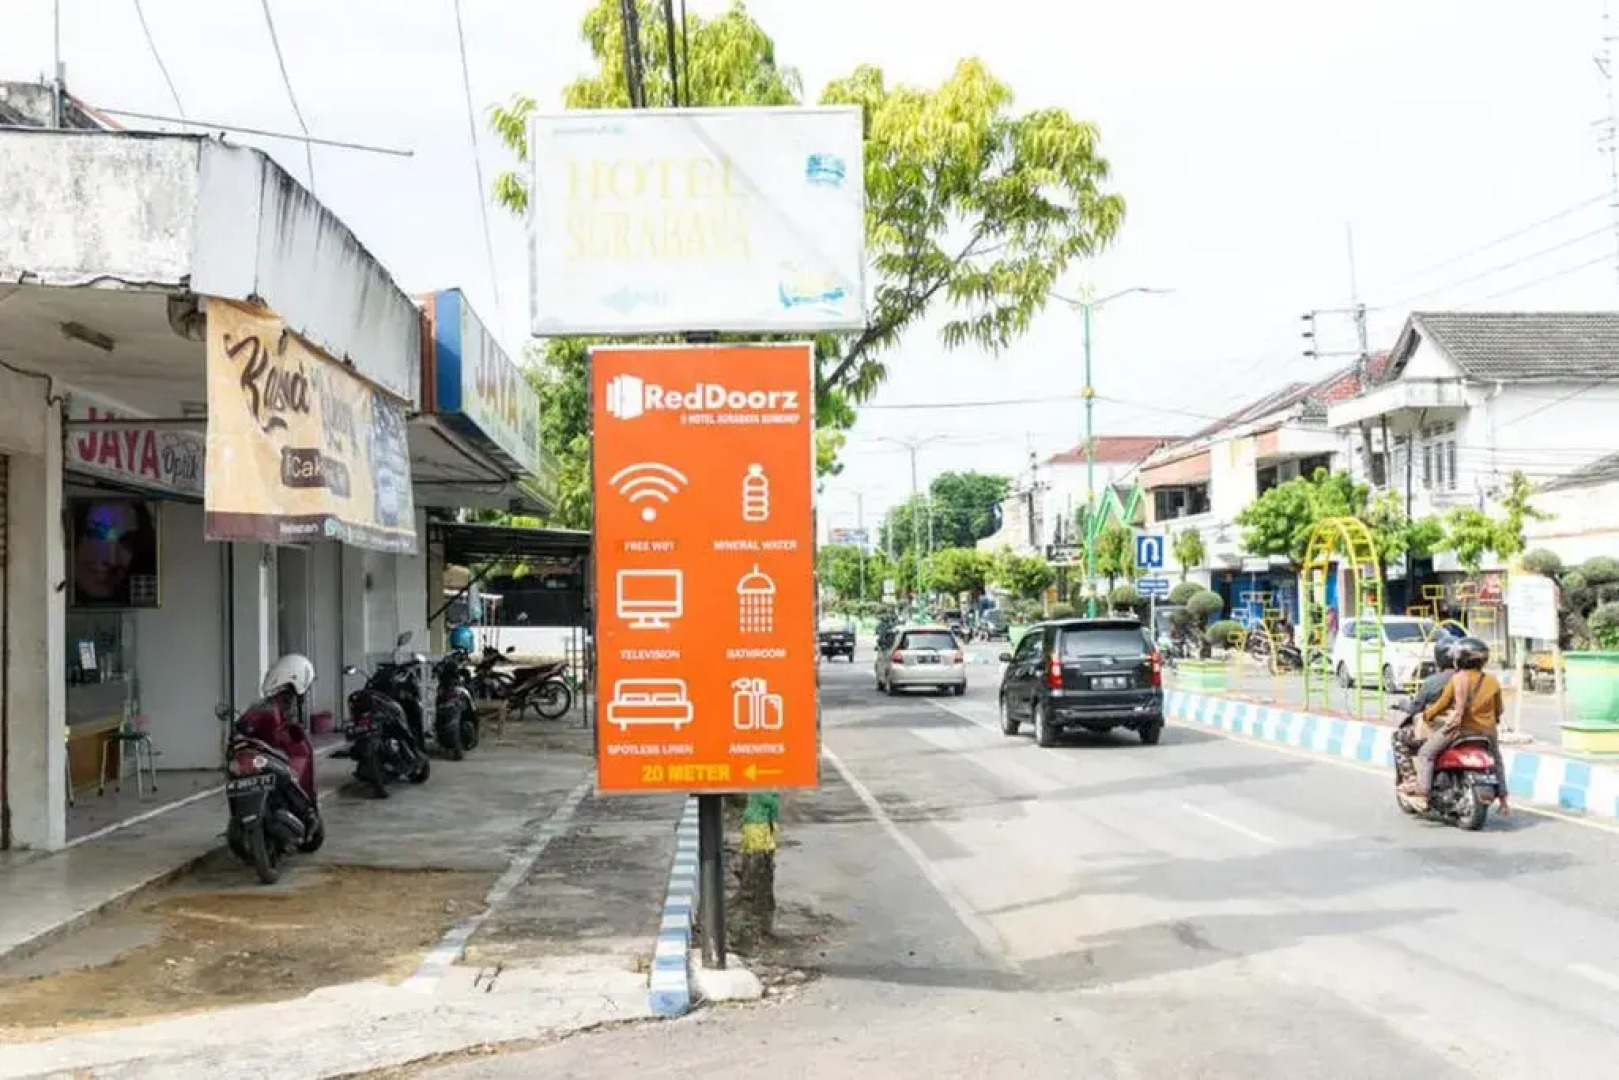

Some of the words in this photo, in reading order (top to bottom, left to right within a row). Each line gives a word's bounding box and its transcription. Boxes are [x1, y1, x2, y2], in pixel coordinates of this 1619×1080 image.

[565, 157, 749, 202] HOTEL
[565, 209, 752, 261] SURABAYA
[644, 383, 799, 410] RedDoorz
[76, 406, 161, 480] JAYA
[624, 540, 650, 552] FREE
[713, 539, 760, 551] MINERAL
[762, 539, 797, 551] WATER
[620, 648, 680, 660] TELEVISION
[726, 648, 786, 659] BATHROOM
[607, 743, 660, 755] SPOTLESS
[662, 743, 694, 755] LINEN
[729, 742, 785, 754] AMENITIES
[641, 763, 664, 783] 20
[668, 763, 731, 783] METER
